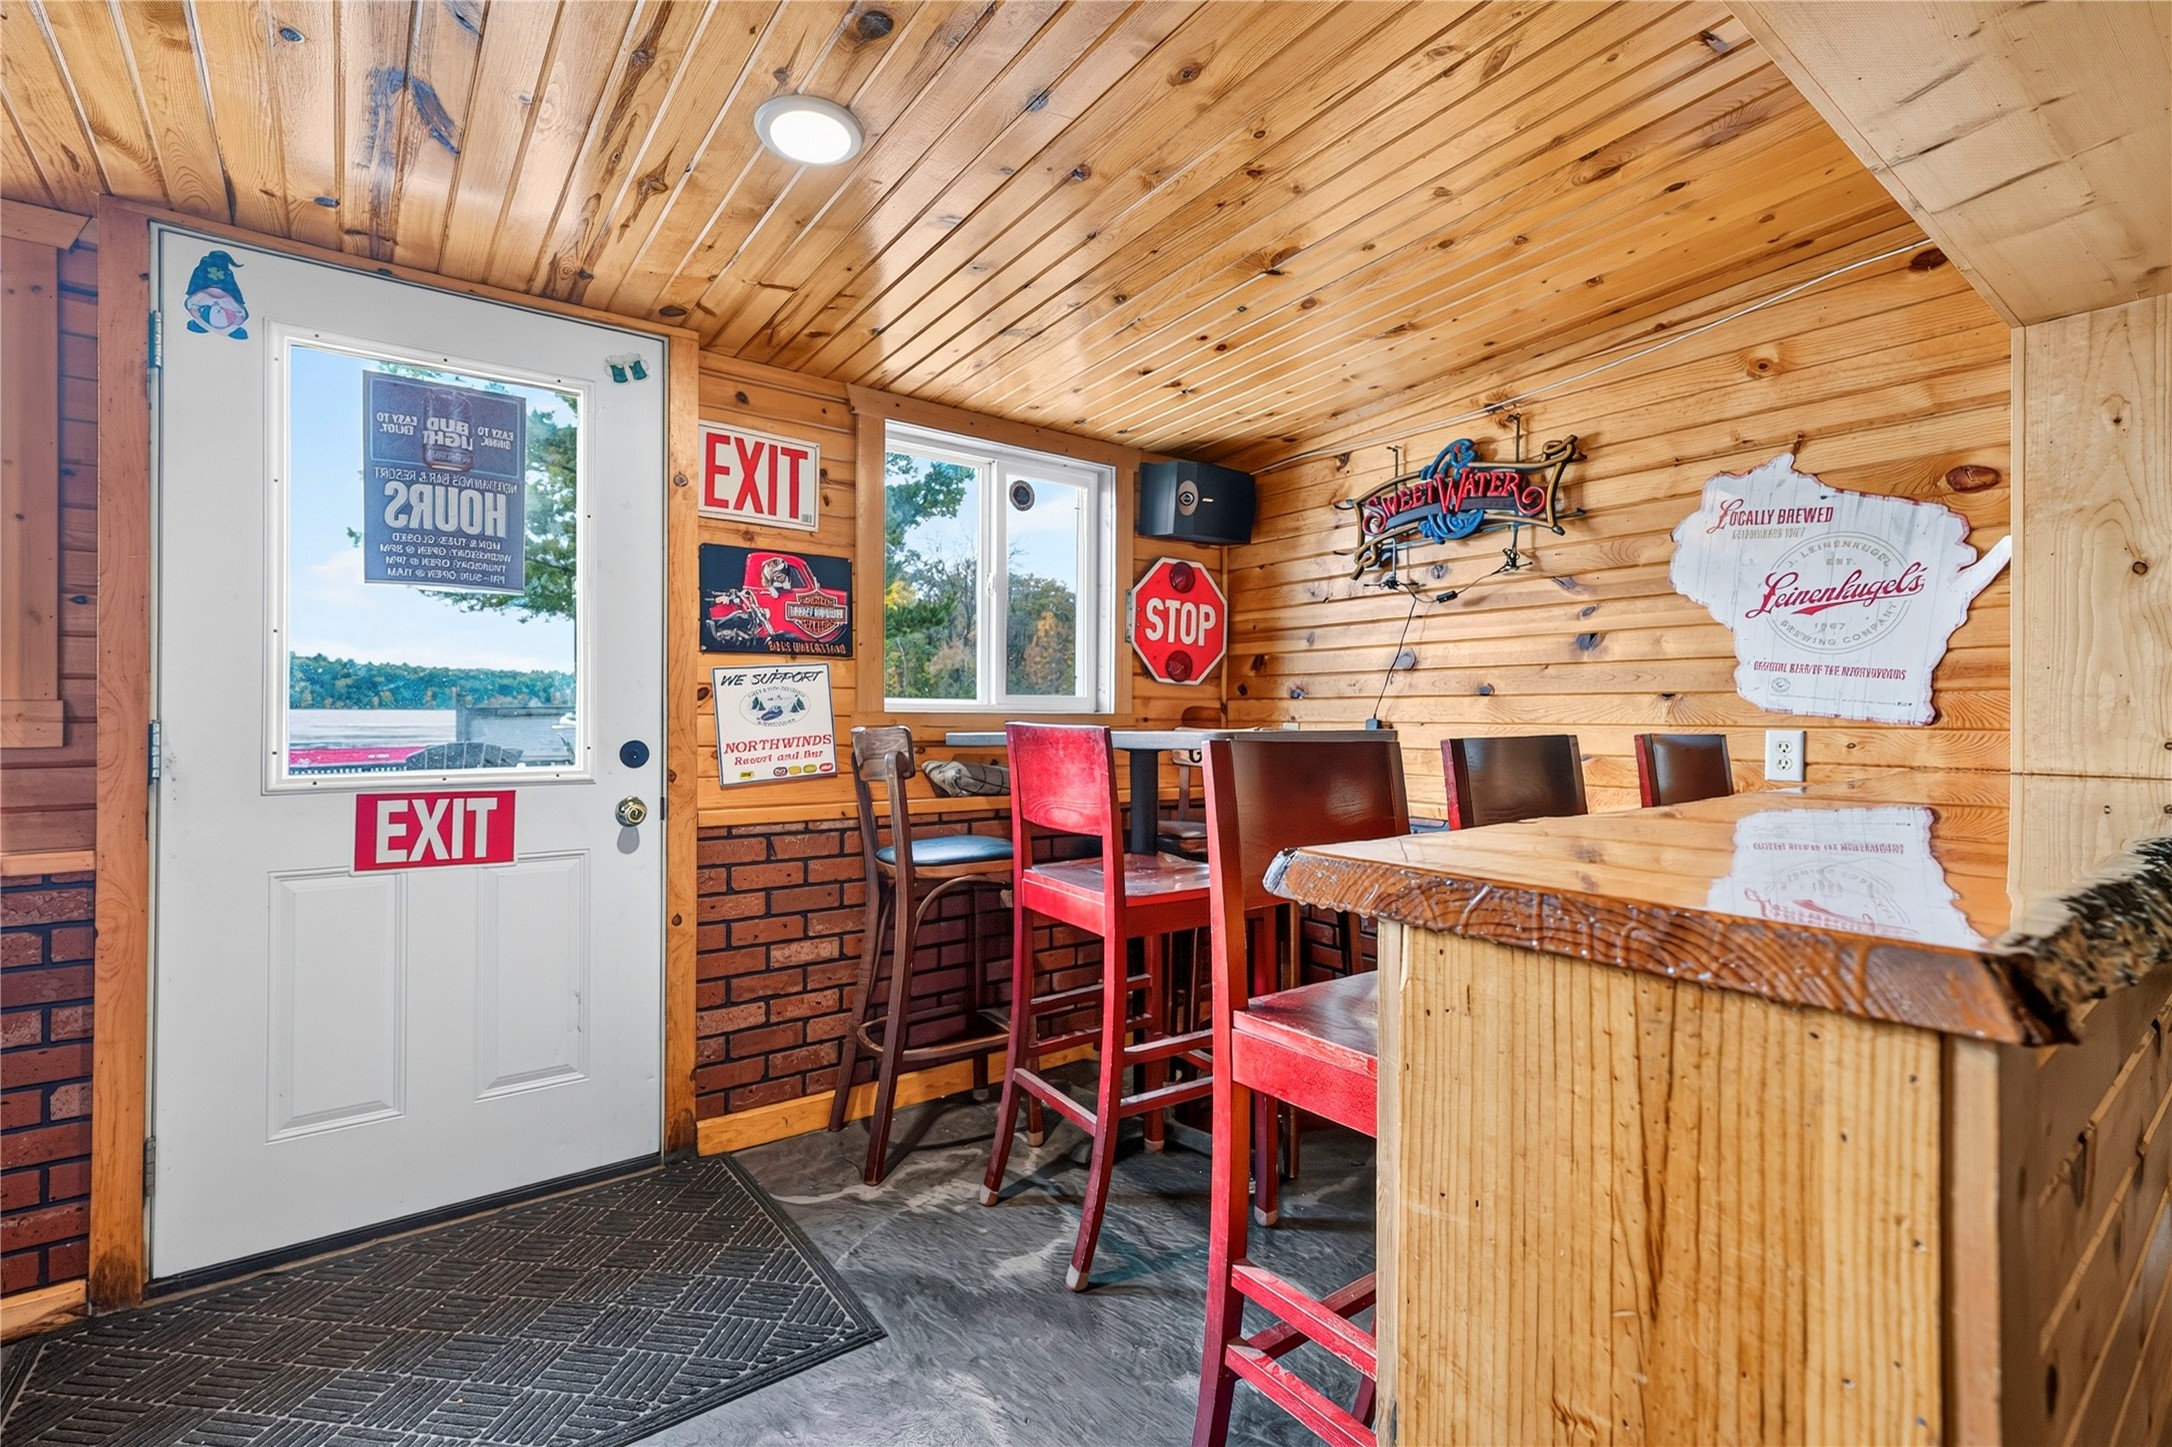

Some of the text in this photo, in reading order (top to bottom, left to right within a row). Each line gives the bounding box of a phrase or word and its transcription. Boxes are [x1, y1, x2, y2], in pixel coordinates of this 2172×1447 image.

[704, 432, 808, 520] EXIT
[1706, 499, 1775, 534] LOCALLY
[1777, 507, 1834, 525] BREWED
[1745, 561, 1928, 619] Leinenkugel's
[1145, 598, 1216, 647] STOP
[1843, 601, 1897, 644] COMPANY
[721, 671, 824, 686] WE SUPPORT
[724, 734, 832, 755] NORTHWINDS
[376, 797, 498, 864] EXIT
